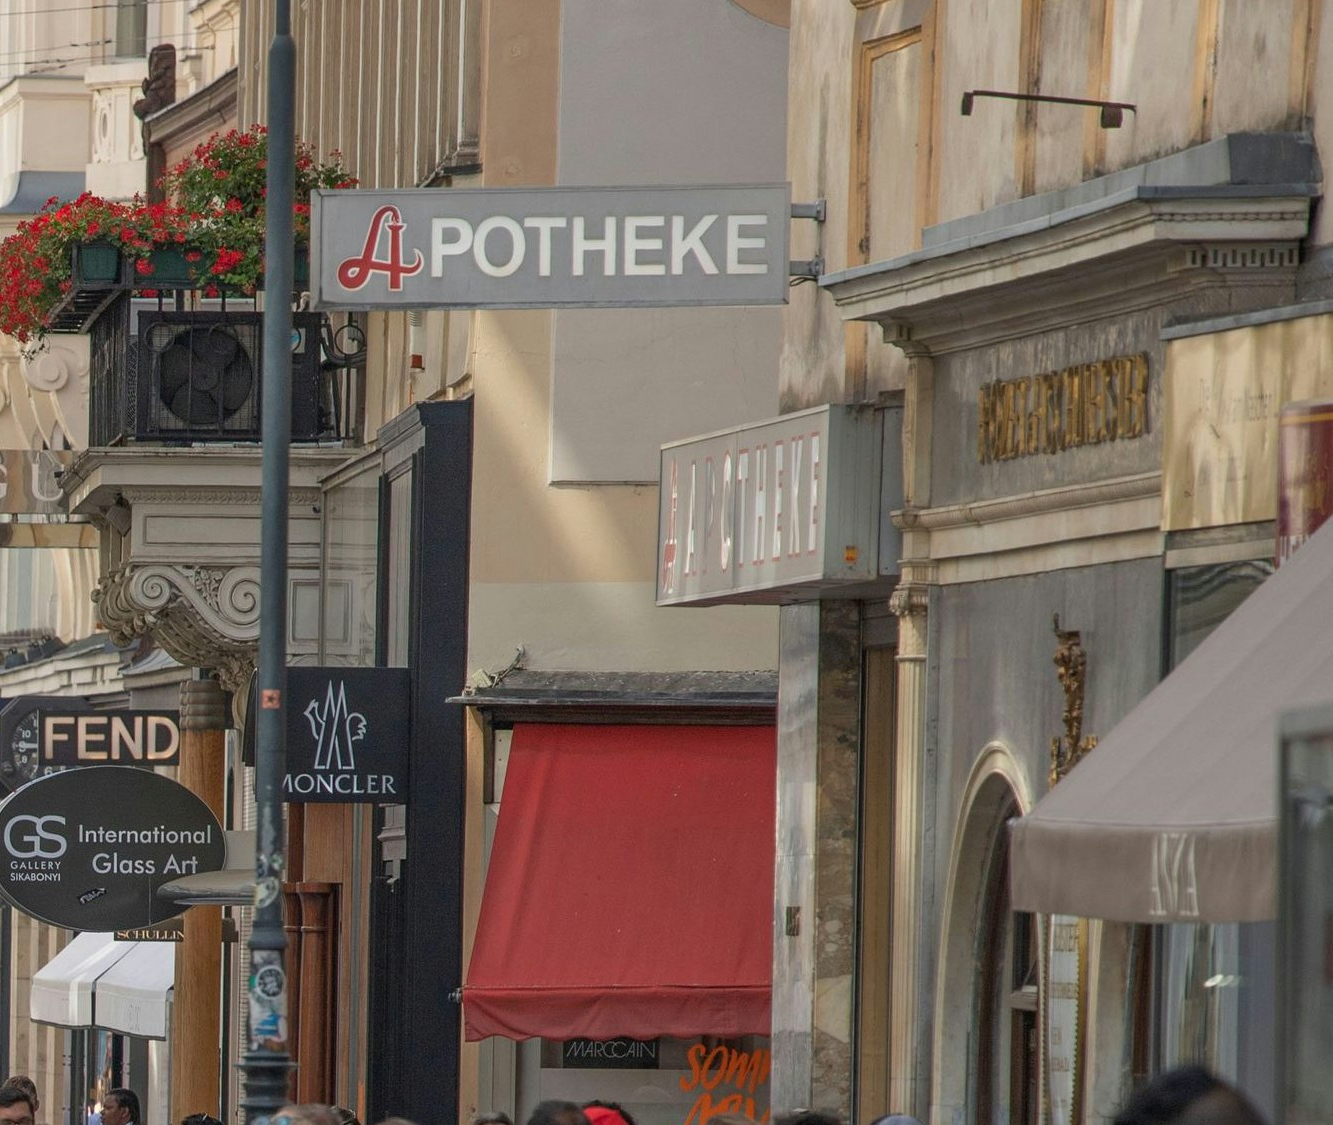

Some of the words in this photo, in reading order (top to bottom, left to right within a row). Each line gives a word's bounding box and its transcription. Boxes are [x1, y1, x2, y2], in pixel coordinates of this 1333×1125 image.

[337, 205, 768, 292] APOTHEKE
[684, 431, 821, 577] APOTHEKE
[4, 815, 67, 858] GS
[78, 824, 211, 844] International
[10, 861, 61, 870] GALLERY
[92, 852, 156, 874] Glass
[163, 854, 198, 874] Art
[10, 873, 61, 882] SIKABONYI
